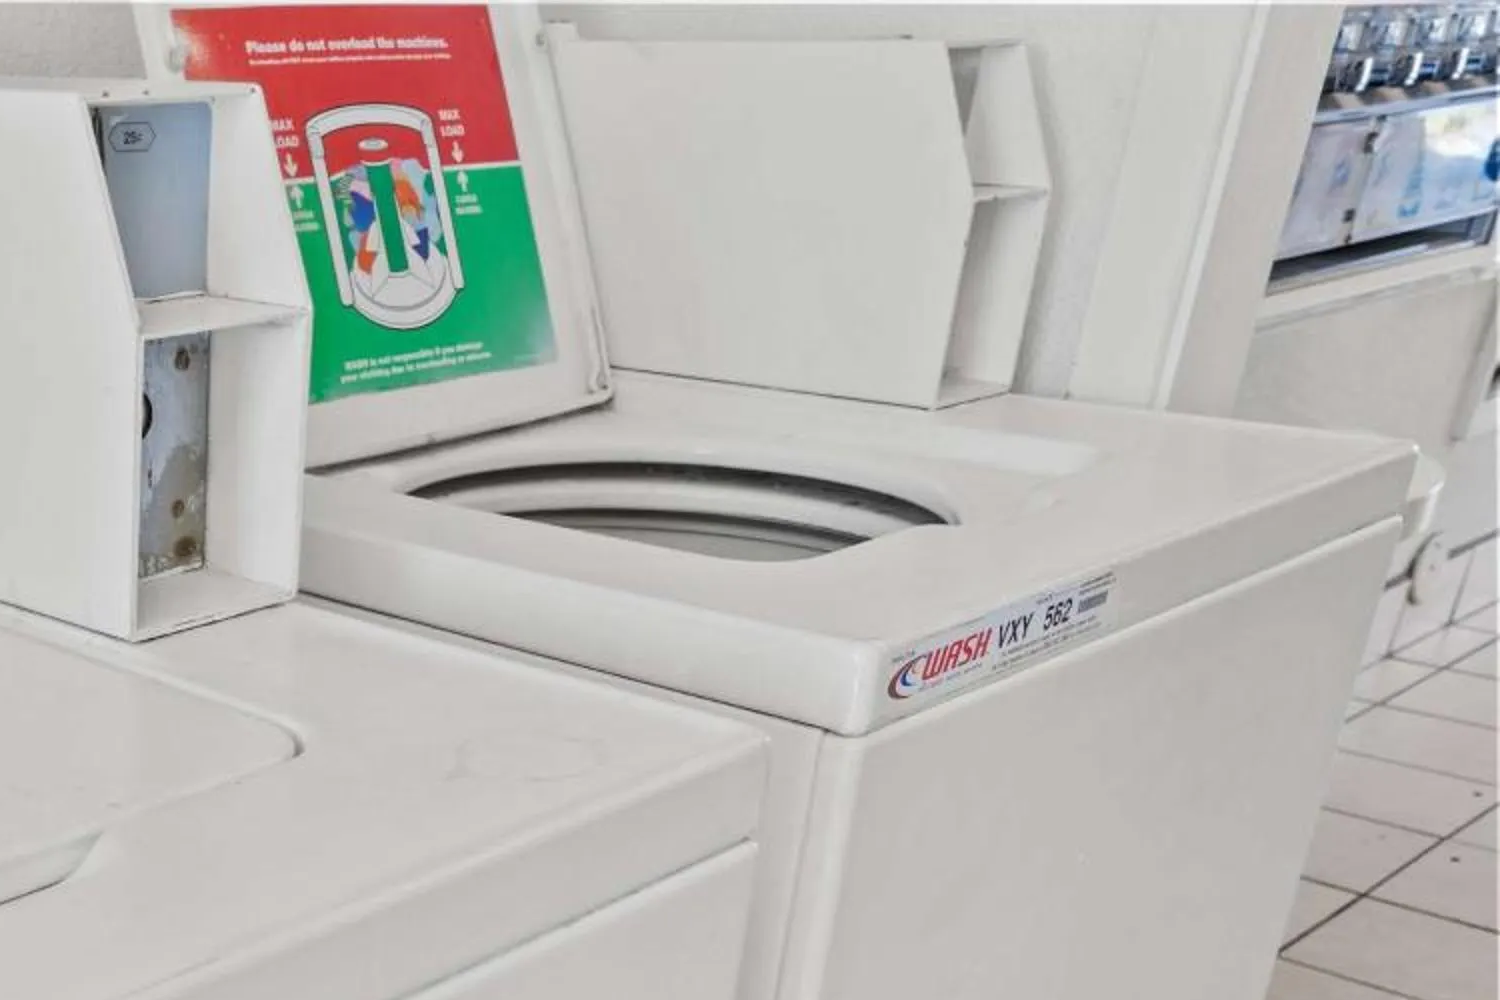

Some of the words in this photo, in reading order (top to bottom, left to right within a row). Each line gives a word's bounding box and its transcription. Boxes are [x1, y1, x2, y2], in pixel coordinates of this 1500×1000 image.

[245, 40, 287, 54] Please
[289, 38, 304, 52] do
[306, 39, 326, 51] not
[376, 36, 395, 49] the
[921, 626, 993, 681] WASH
[998, 610, 1036, 649] VXY
